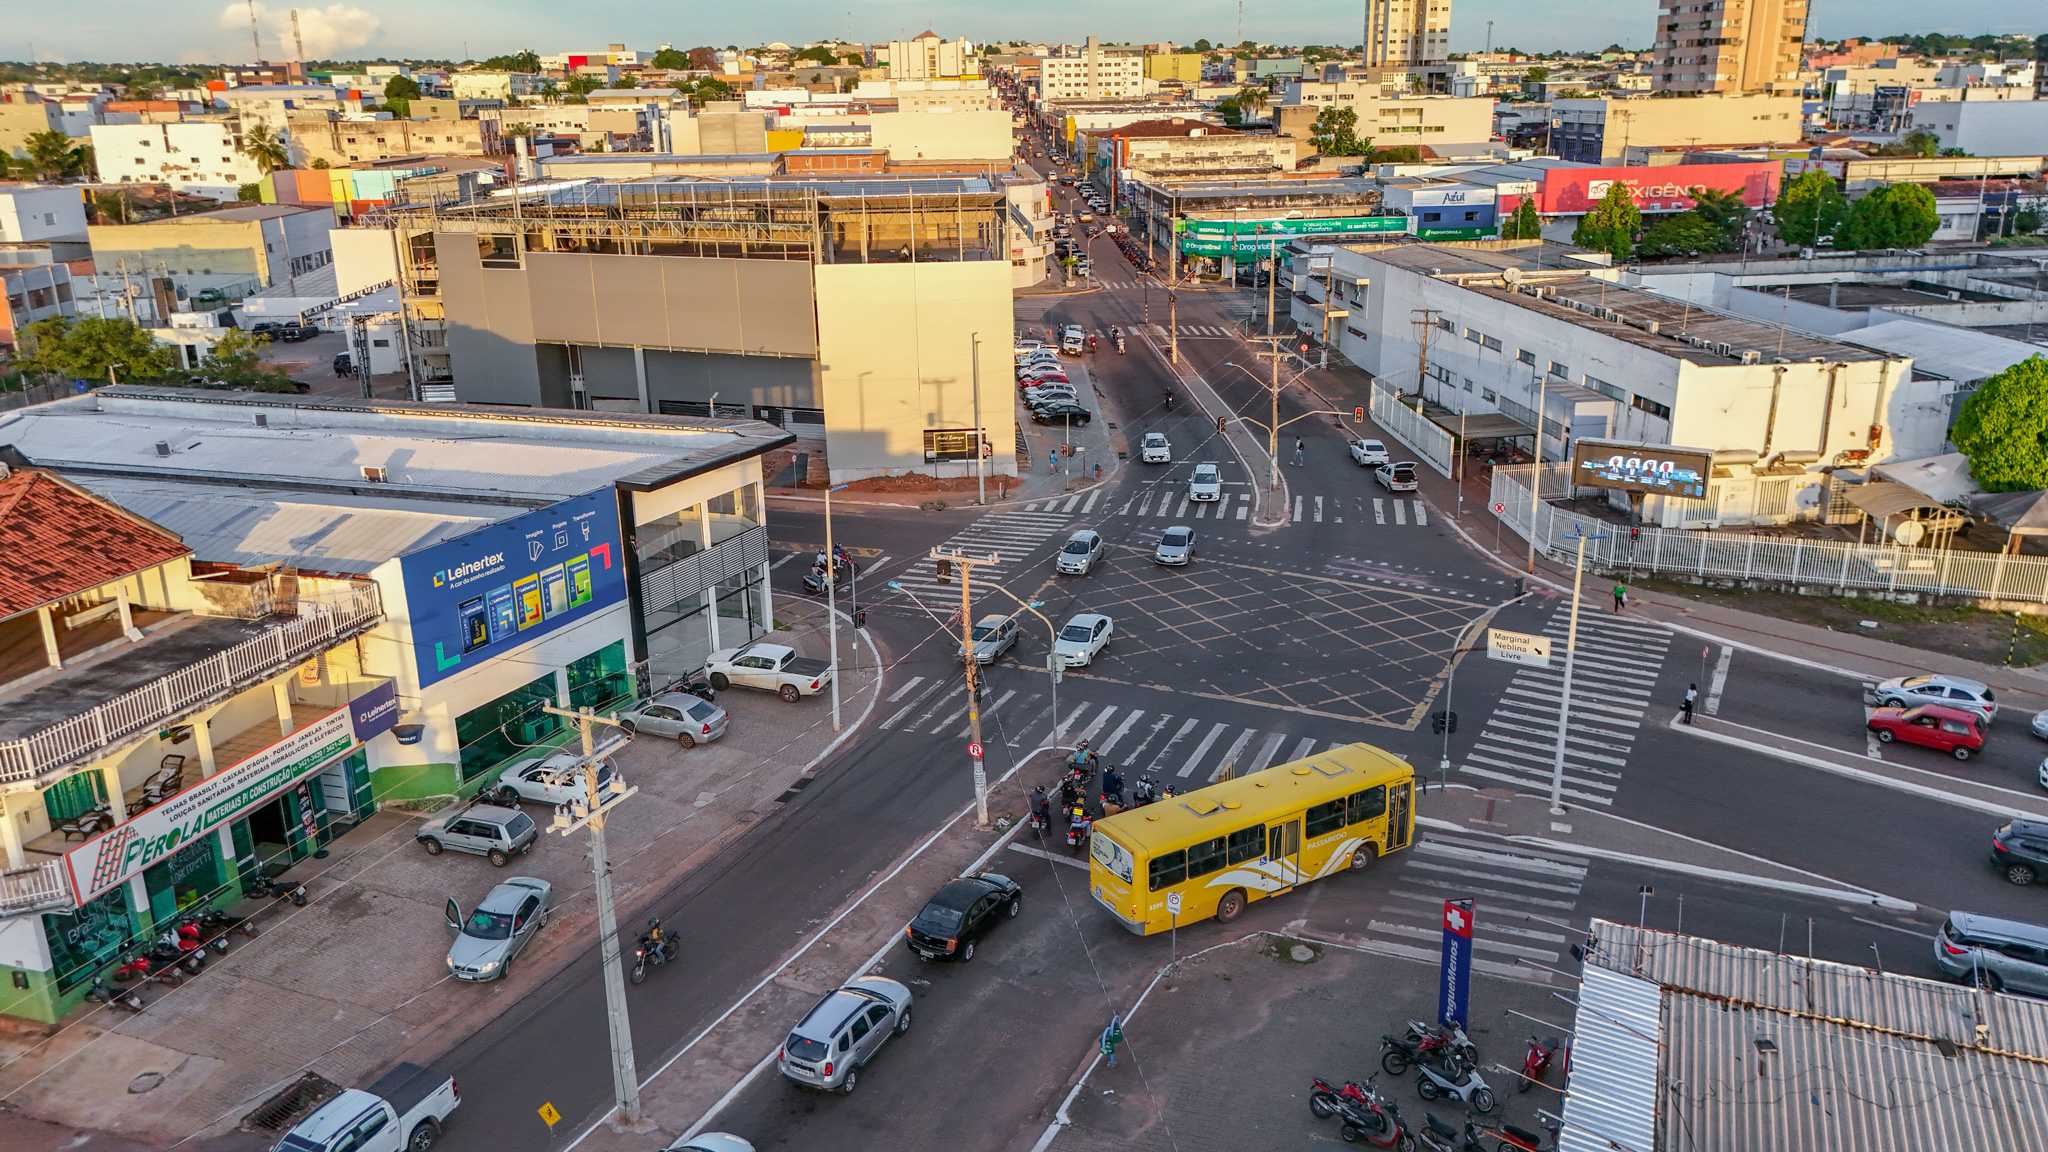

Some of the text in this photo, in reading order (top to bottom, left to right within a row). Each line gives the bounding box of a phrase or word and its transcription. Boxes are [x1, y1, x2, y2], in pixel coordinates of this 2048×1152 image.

[1442, 192, 1465, 204] Azul
[448, 552, 504, 581] Leinertex
[470, 572, 484, 582] sonho
[485, 565, 505, 576] realizado
[1494, 633, 1530, 644] Marginal
[1496, 642, 1527, 652] Neblina
[1501, 651, 1521, 660] Livre
[367, 699, 396, 718] Leinertex
[161, 799, 188, 816] TELHAS
[189, 782, 218, 802] BRASILIT
[222, 768, 246, 783] CAIXAS
[273, 741, 295, 756] PORTAS
[298, 726, 322, 742] JANELAS
[326, 714, 344, 727] TINTAS
[207, 796, 241, 824] MATERIAIS
[250, 768, 290, 799] CONSTRUÇÃO
[170, 804, 196, 822] LOUÇAS
[121, 814, 202, 877] PÉROLA
[1307, 831, 1347, 850] PASSAREDO
[1149, 902, 1163, 911] 5390
[1445, 939, 1458, 1022] PagueMenos
